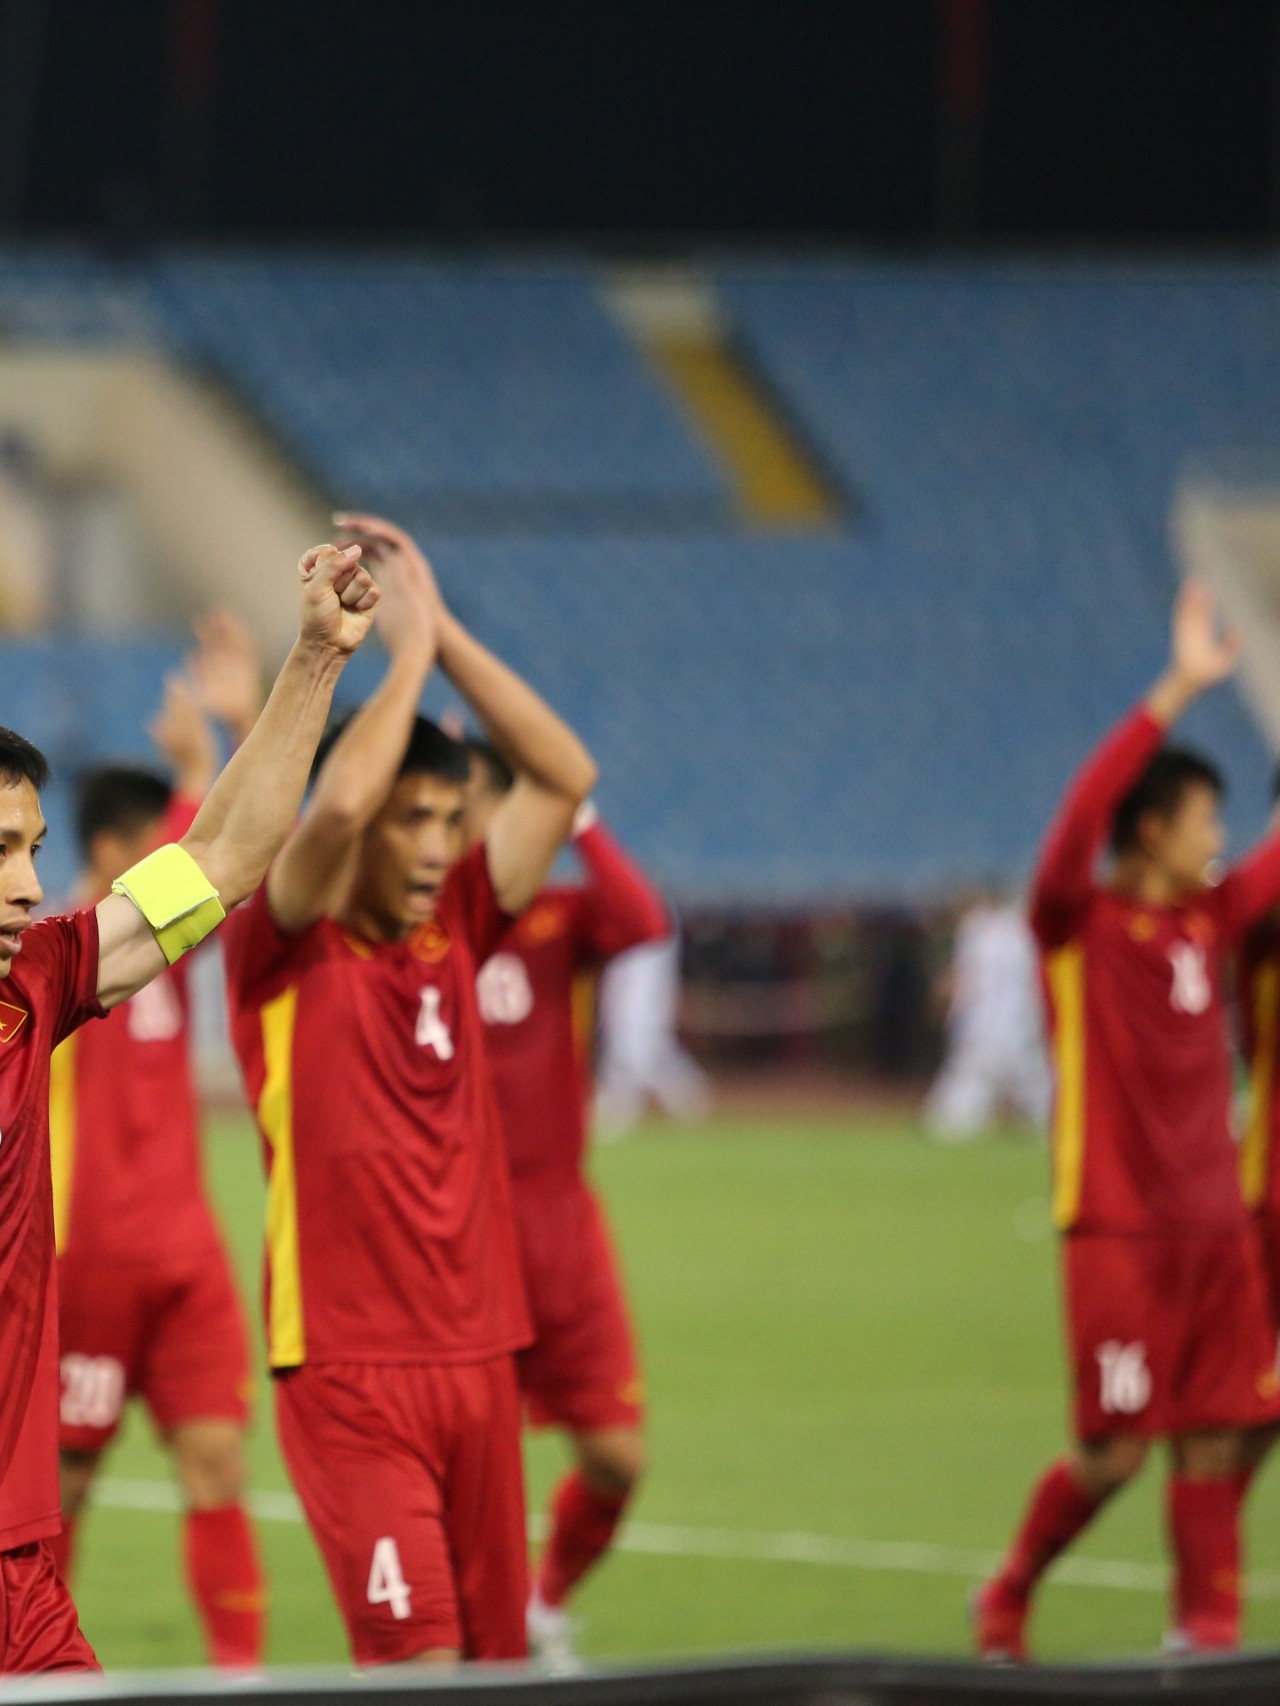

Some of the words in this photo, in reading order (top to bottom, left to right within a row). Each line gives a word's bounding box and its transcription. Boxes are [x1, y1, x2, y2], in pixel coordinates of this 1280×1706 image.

[415, 985, 454, 1060] 4
[1095, 1339, 1152, 1414] 16
[367, 1536, 411, 1619] 4
